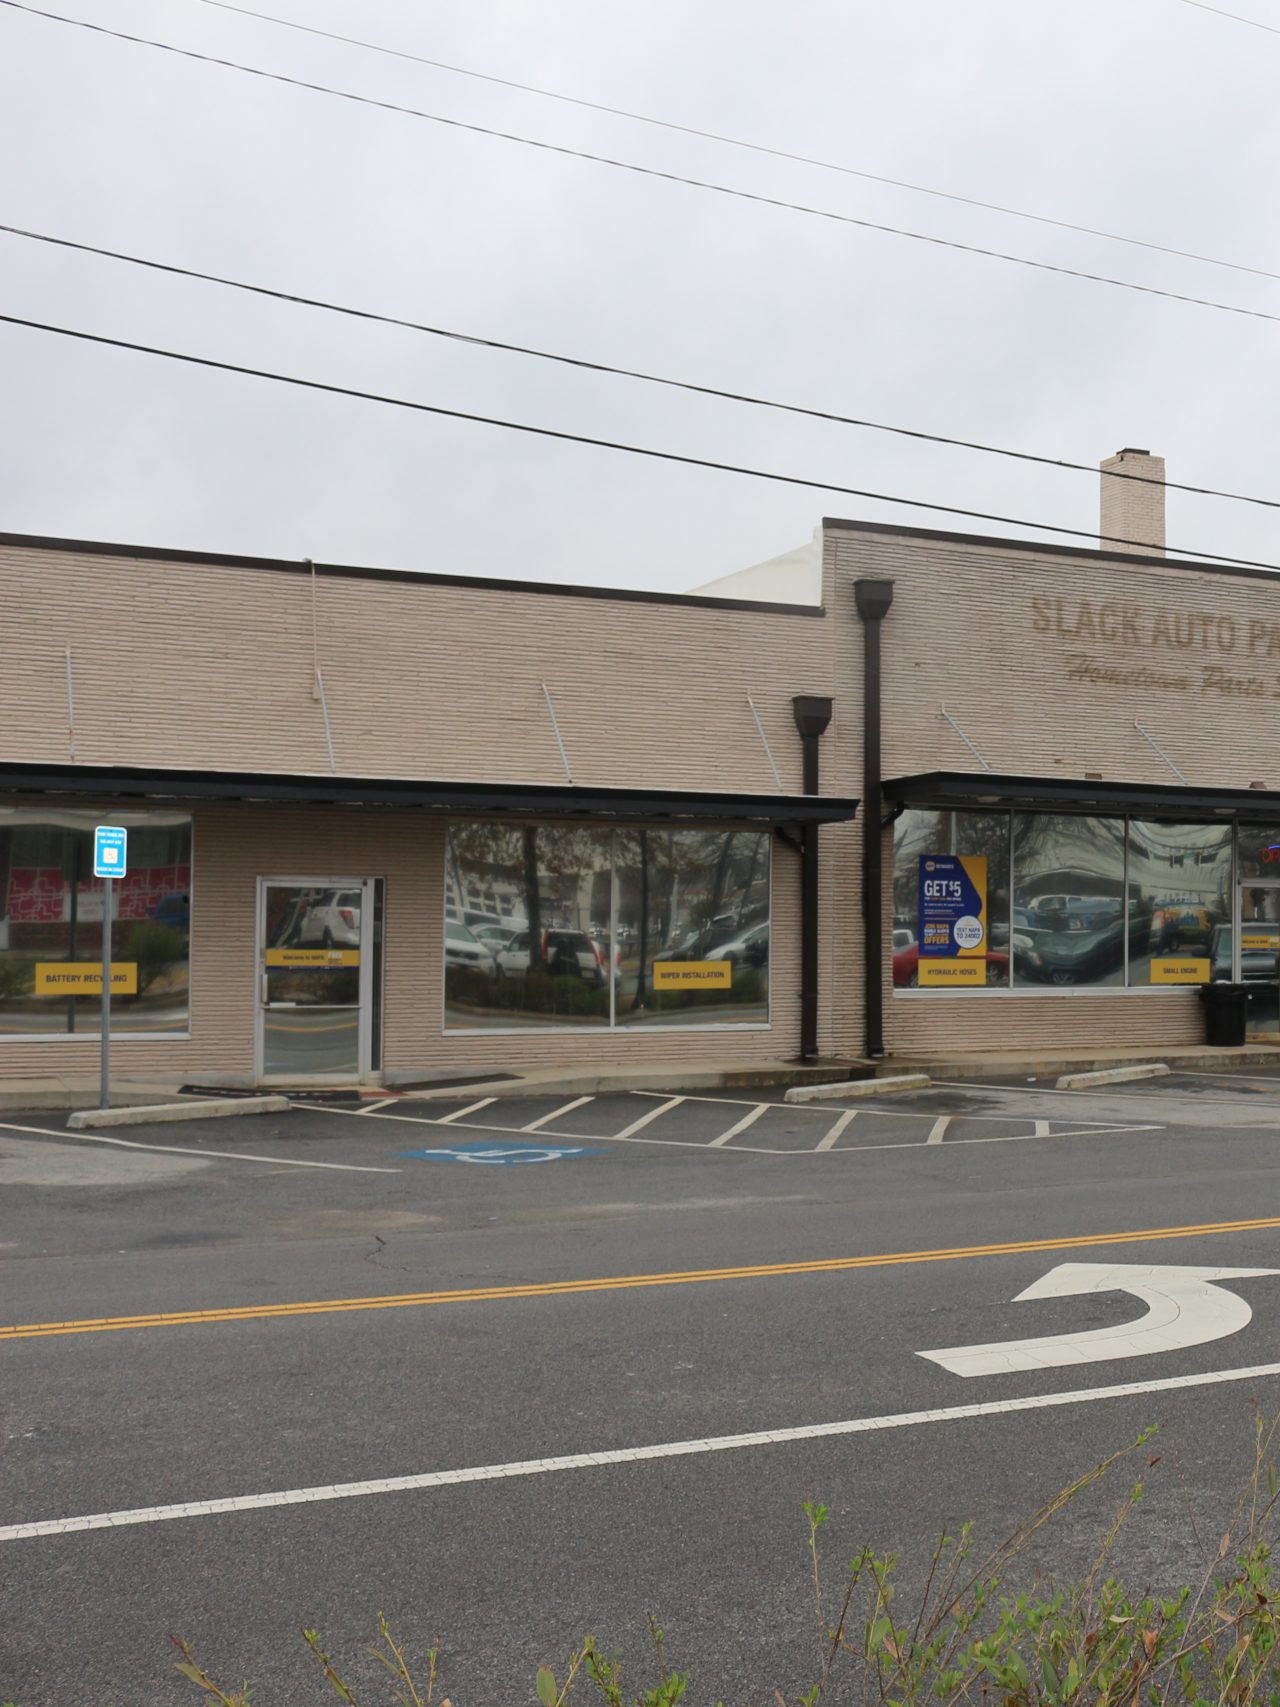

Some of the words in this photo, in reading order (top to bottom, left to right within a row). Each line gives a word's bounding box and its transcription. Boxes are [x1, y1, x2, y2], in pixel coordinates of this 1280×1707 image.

[1031, 597, 1141, 646] SLACK
[1151, 611, 1237, 652] AUTO
[1063, 653, 1193, 692] Hometown
[1200, 665, 1266, 698] Parts
[924, 880, 948, 897] GET
[949, 880, 962, 897] $5
[924, 936, 949, 944] OFFERS
[661, 971, 680, 979] WIPER
[682, 971, 724, 979] INSTALLATION
[928, 968, 958, 976] HYDRAULIC
[959, 968, 977, 976] HOSES
[46, 974, 82, 983] BATTERY
[83, 974, 128, 983] RECYLING
